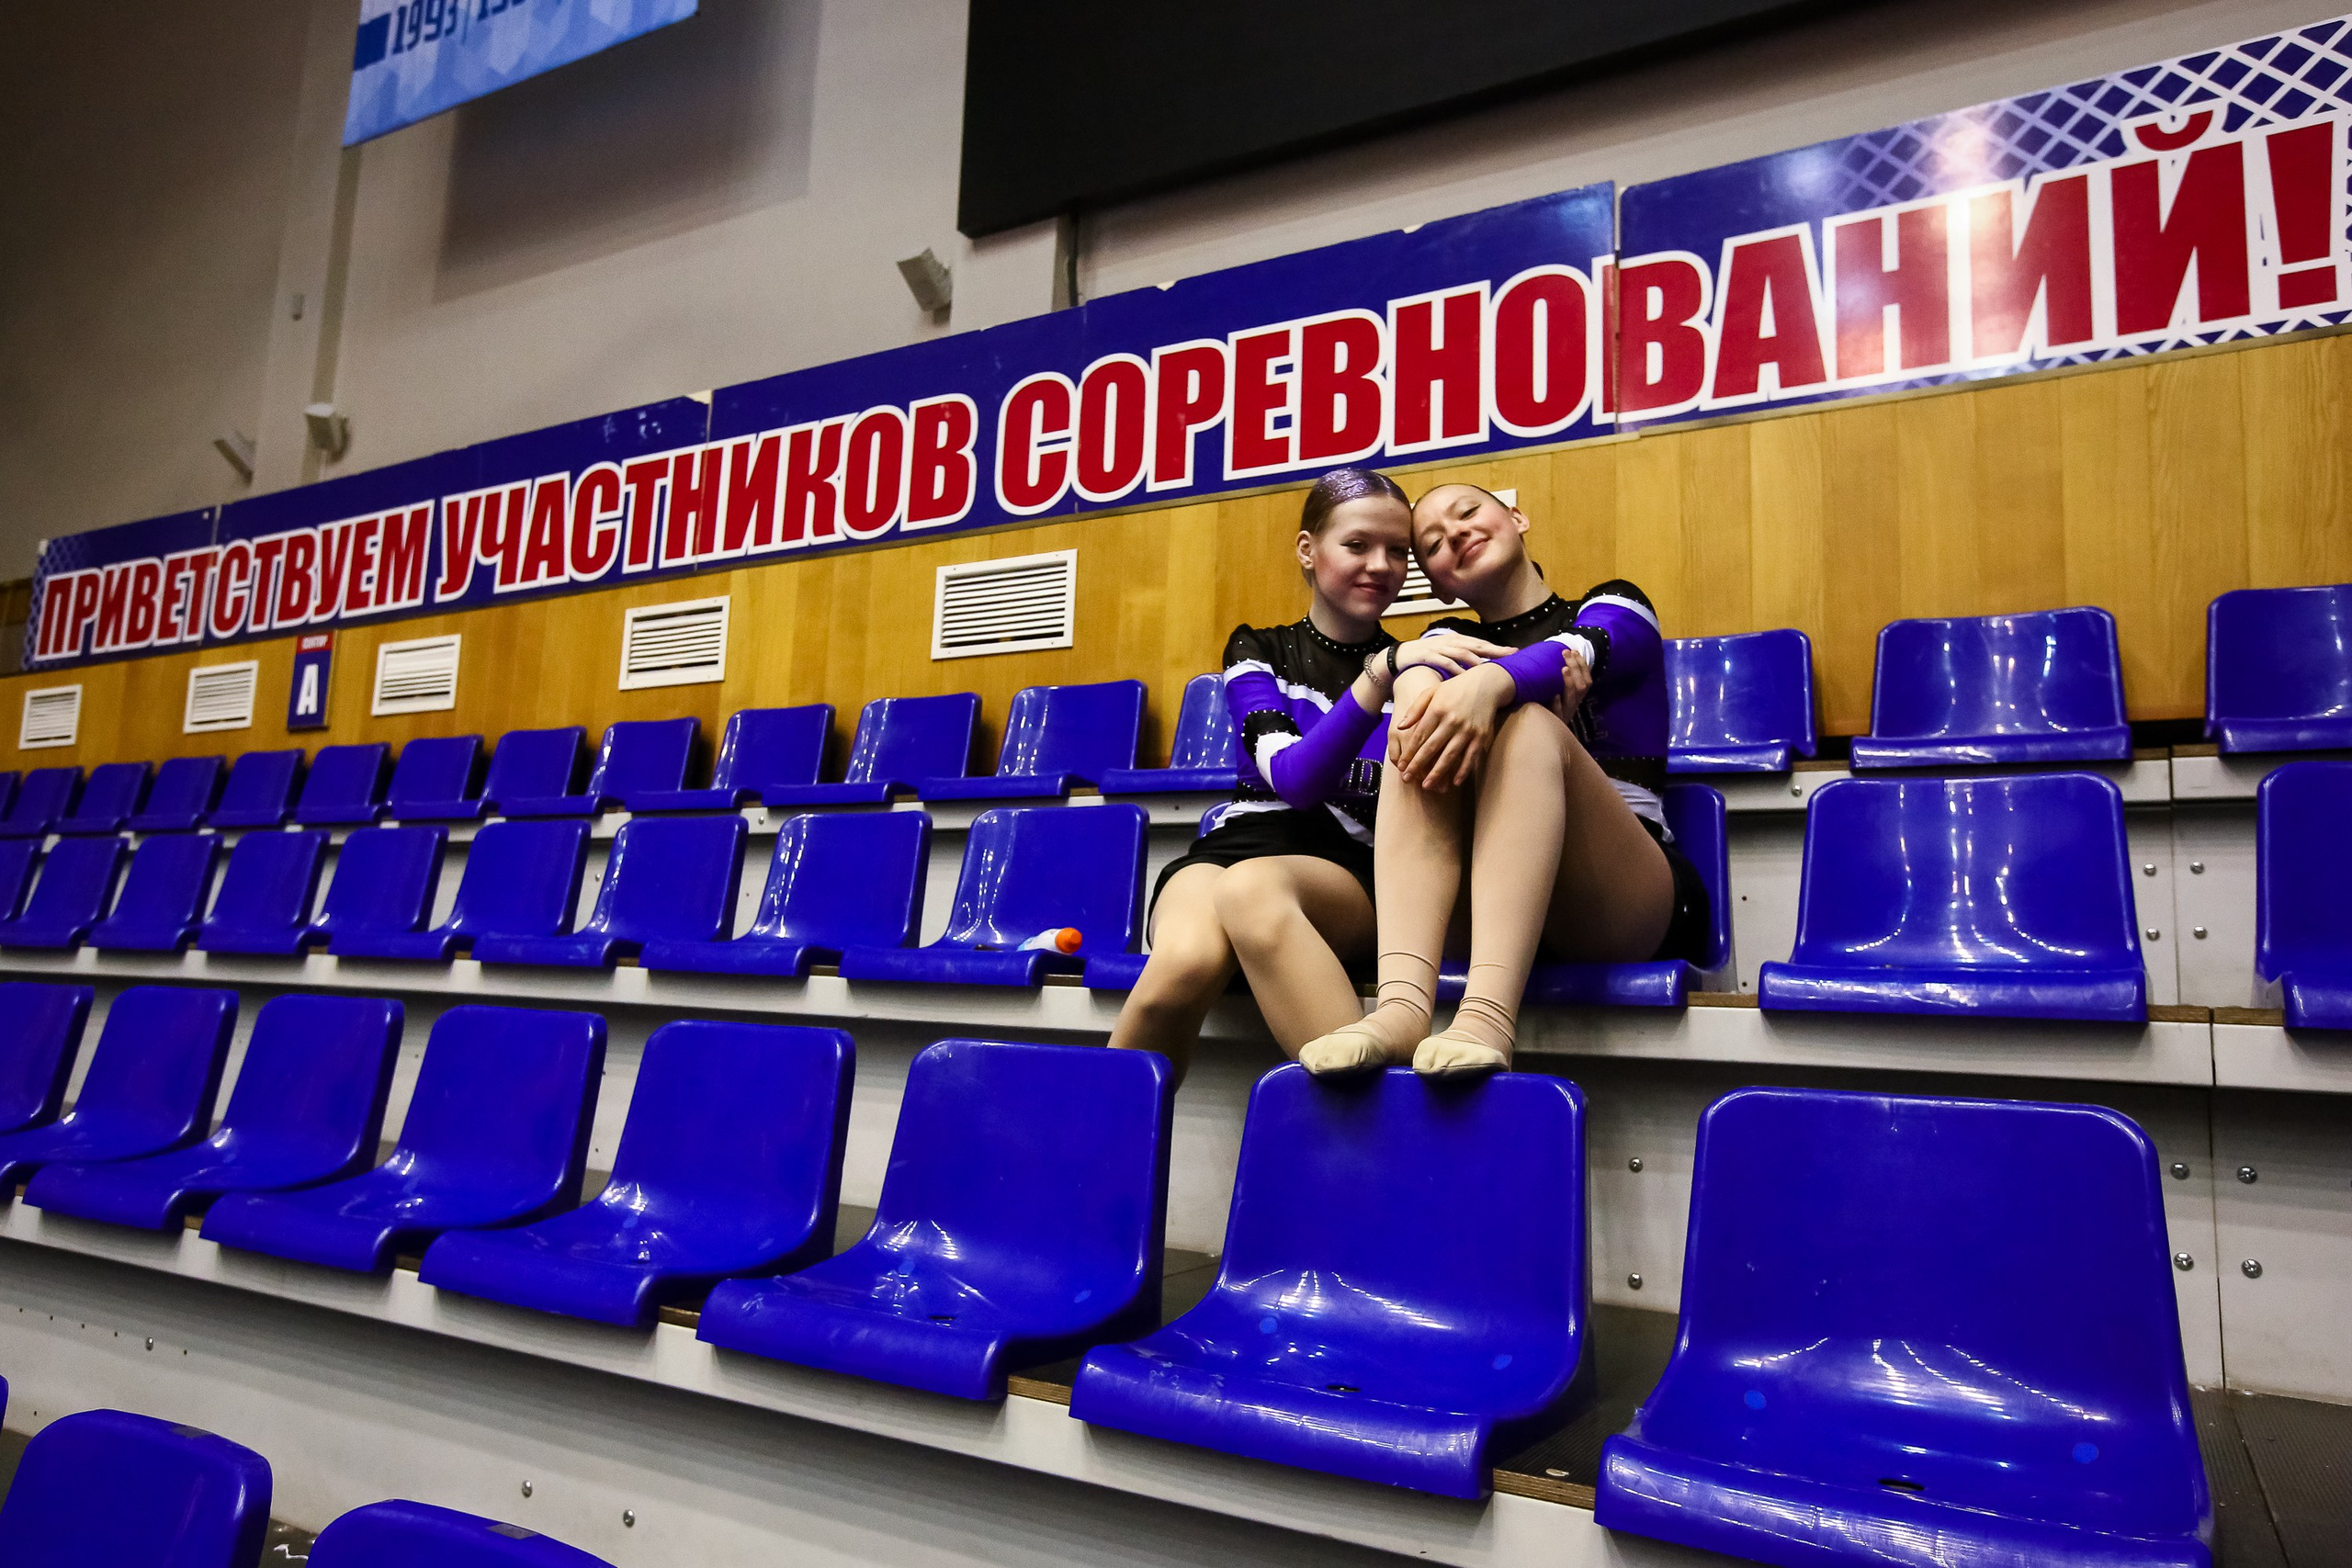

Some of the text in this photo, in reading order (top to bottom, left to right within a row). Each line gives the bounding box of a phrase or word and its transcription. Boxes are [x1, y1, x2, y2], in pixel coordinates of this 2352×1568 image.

[34, 98, 2349, 661] ПРИВЕТСТВУЕМ УЧАСТНИКОВ СОРЕВНОВАНИЙ!
[297, 663, 319, 716] А
